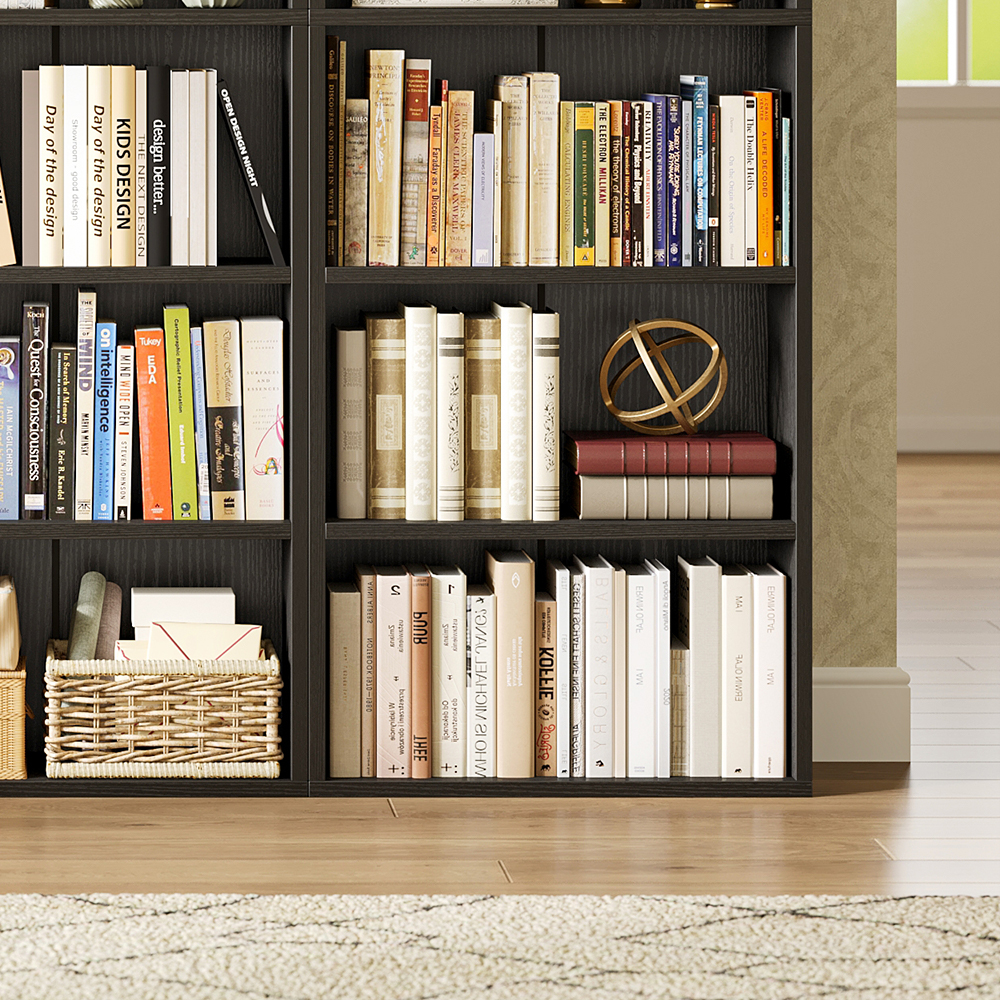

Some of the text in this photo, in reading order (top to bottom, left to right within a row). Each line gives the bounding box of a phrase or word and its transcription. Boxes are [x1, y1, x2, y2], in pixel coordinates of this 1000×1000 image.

[221, 88, 259, 187] OPEN DESIGN NIGHT
[431, 147, 440, 175] Faraday
[433, 114, 441, 138] Tyndall
[598, 107, 607, 204] THE ELECTRON MILLIKAN
[747, 117, 755, 191] The Double Helix
[91, 105, 105, 237] Day of the design
[116, 118, 131, 230] KIDS DESIGN
[149, 119, 166, 214] design better...
[432, 177, 439, 186] as
[431, 195, 439, 233] Discoverer
[28, 339, 44, 377] Quest
[139, 337, 162, 346] Tukey
[98, 328, 113, 433] on intelligence
[119, 355, 131, 427] MIND WIDE OPEN
[29, 388, 43, 481] Consciousness
[57, 475, 65, 500] Kandel
